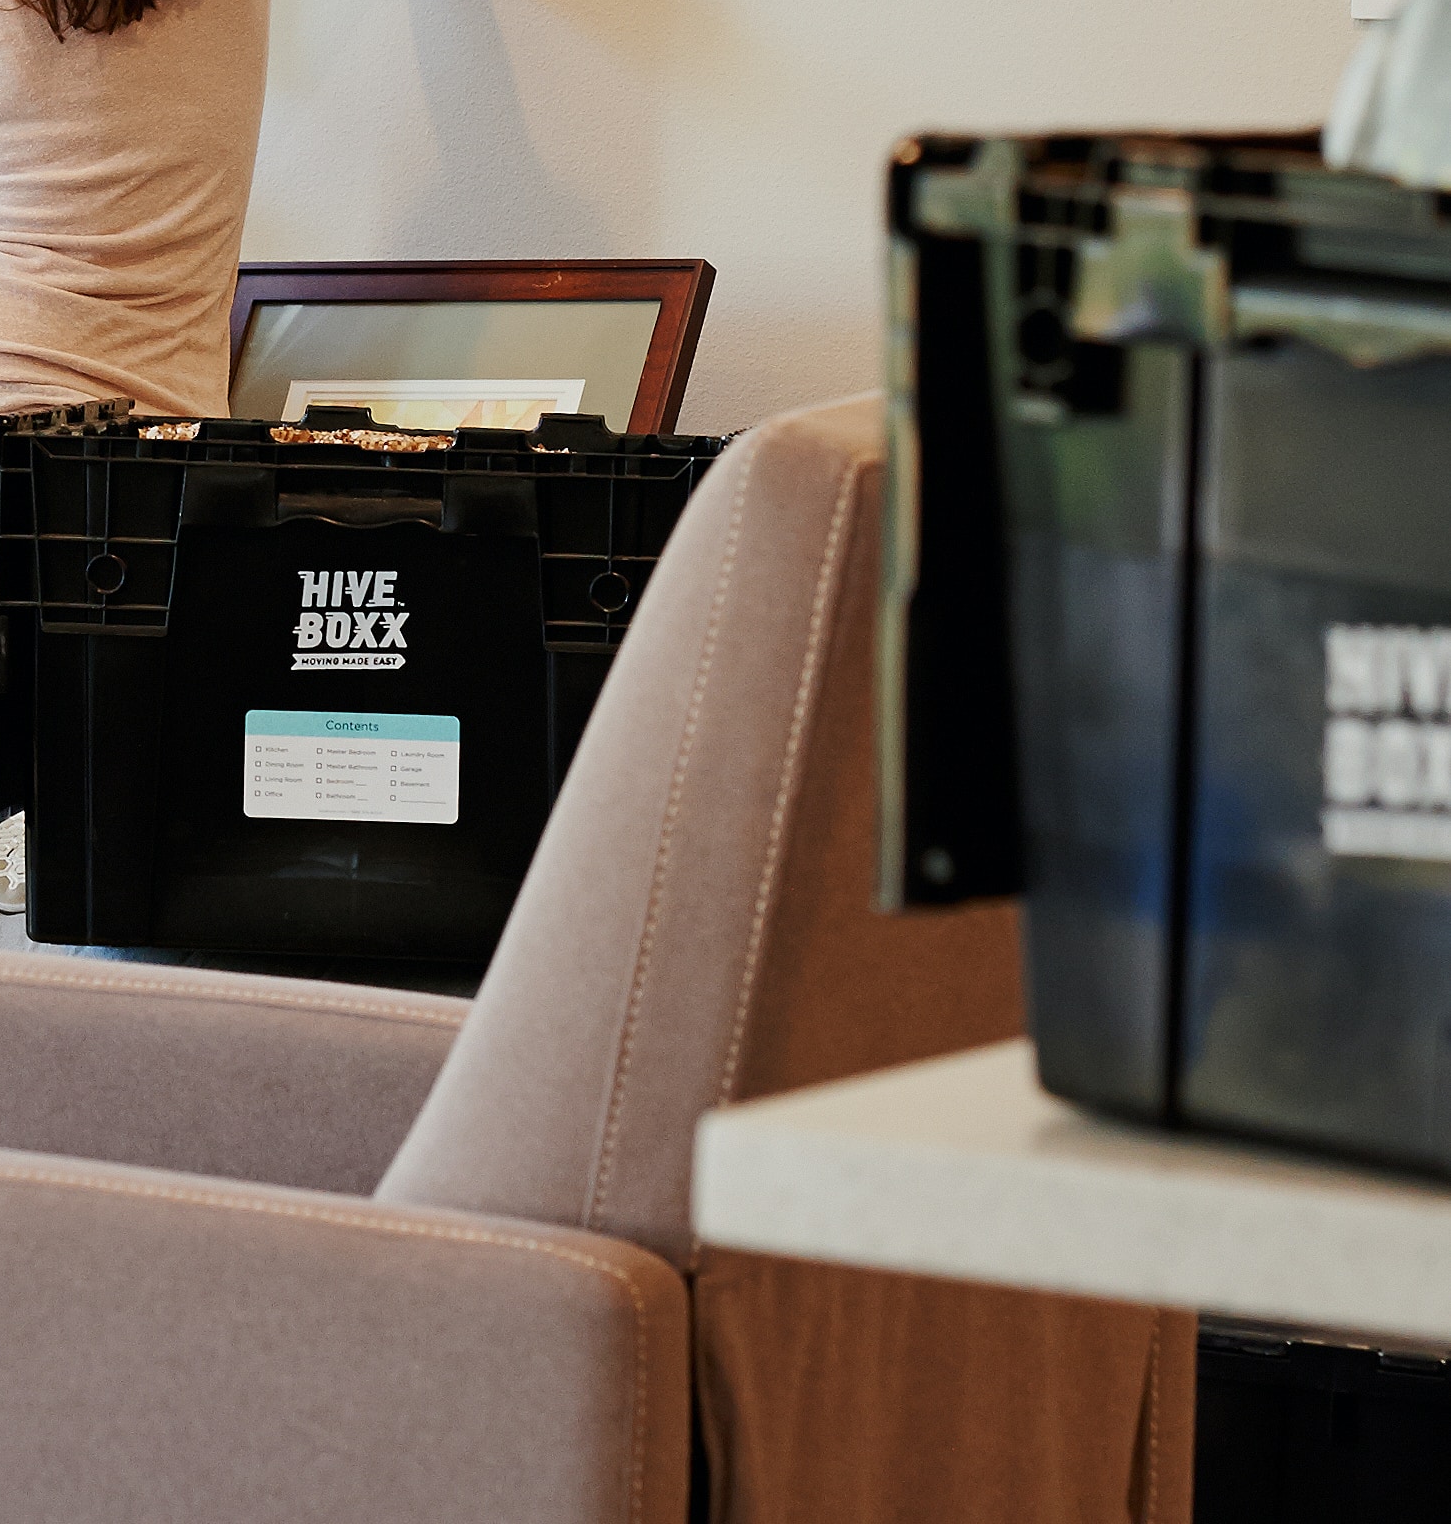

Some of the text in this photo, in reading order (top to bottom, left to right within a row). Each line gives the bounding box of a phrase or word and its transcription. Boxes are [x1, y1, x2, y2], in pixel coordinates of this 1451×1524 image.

[298, 571, 397, 607] HIVE
[293, 612, 410, 648] BOXX
[325, 720, 379, 732] Contents
[1323, 719, 1451, 806] BOX
